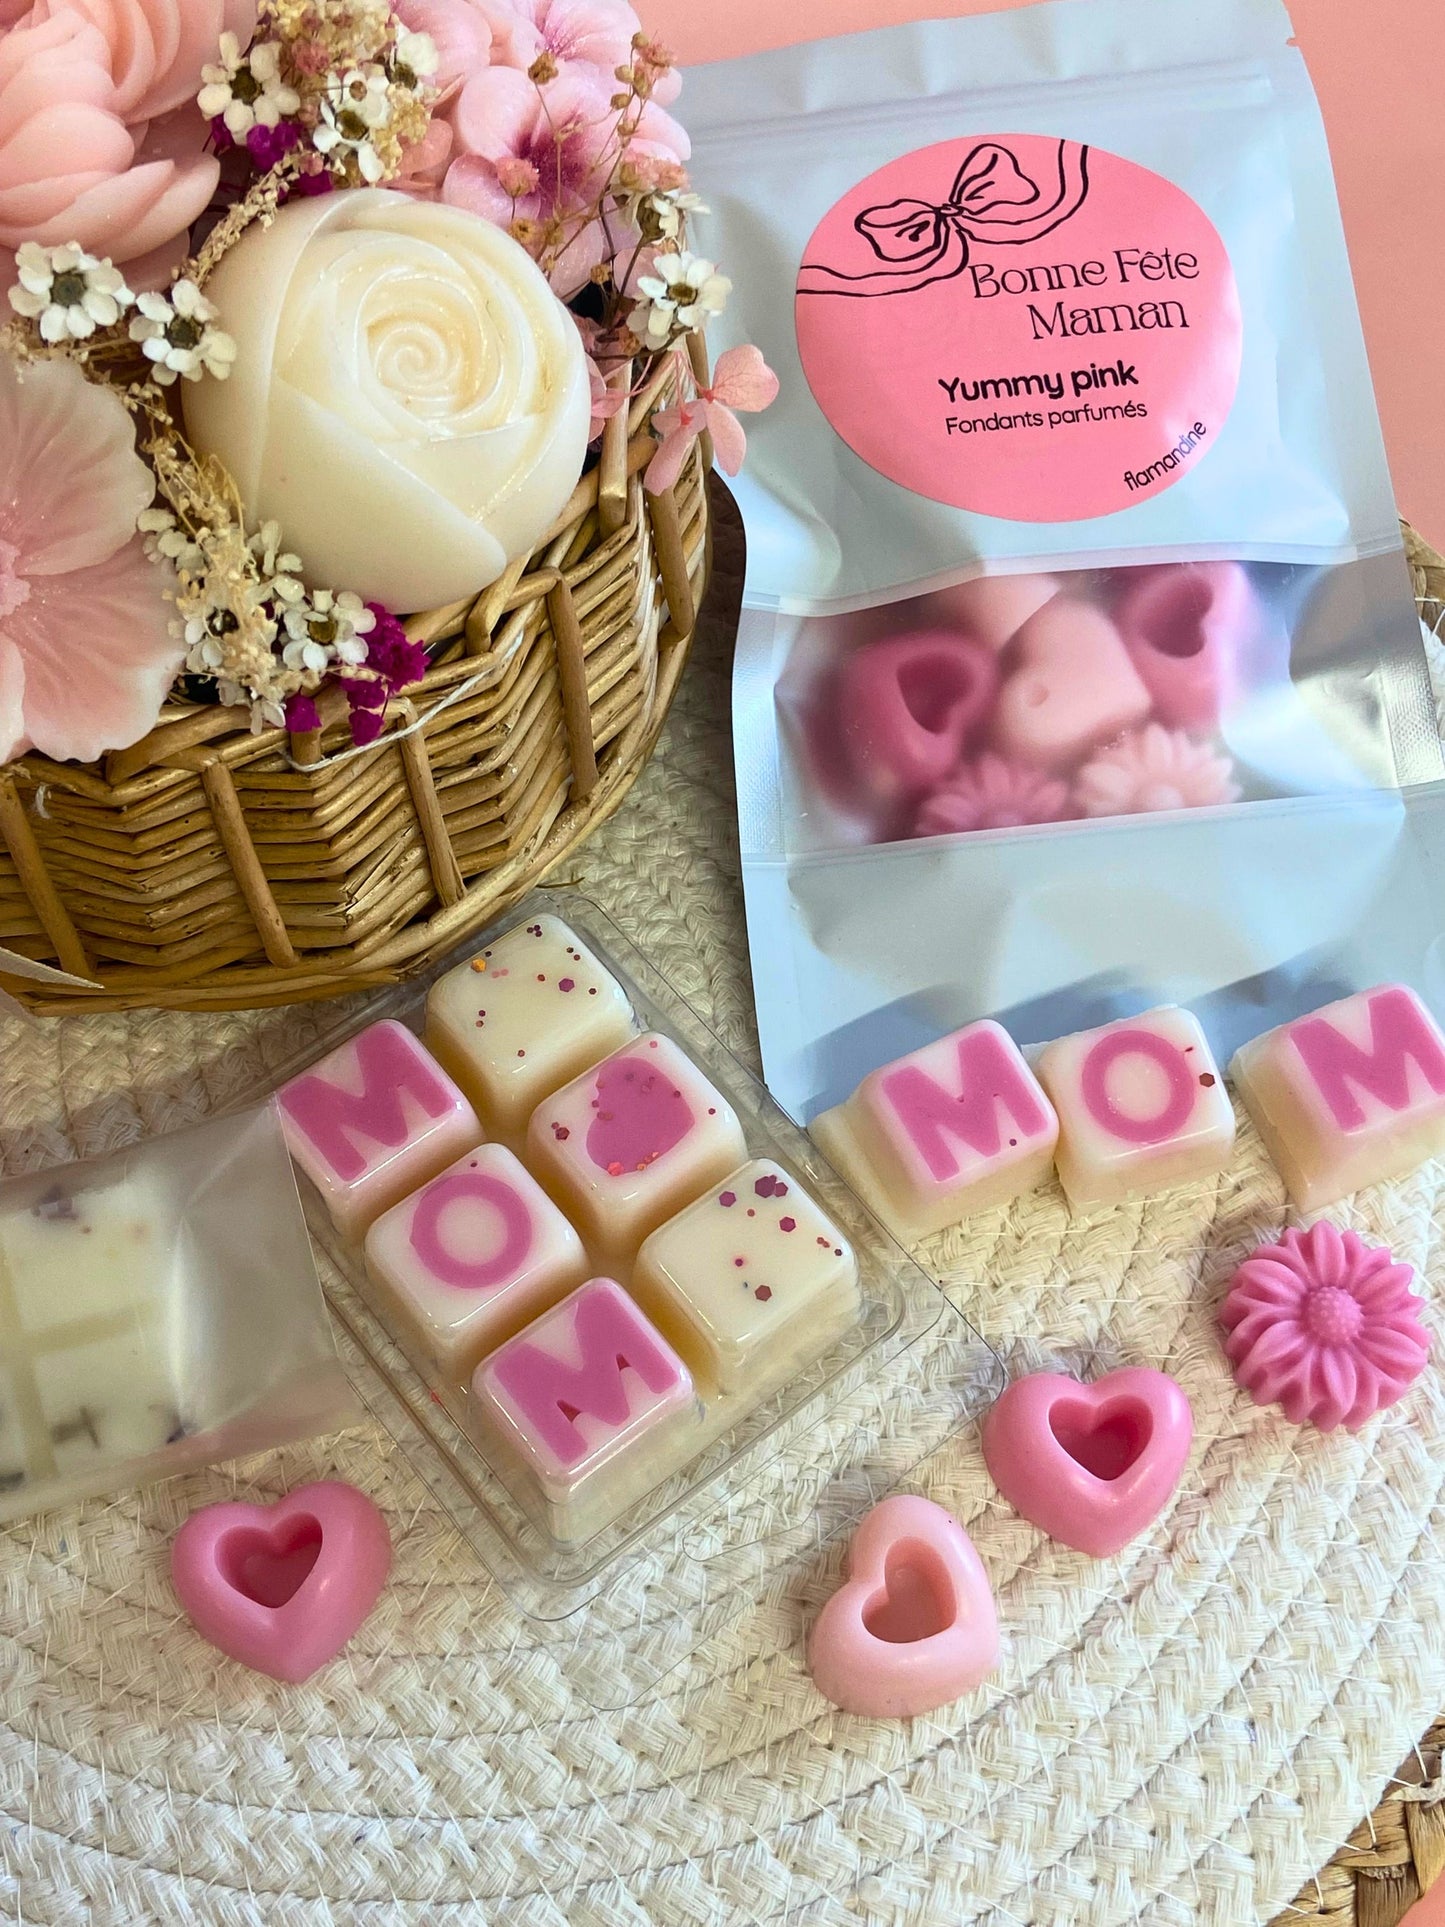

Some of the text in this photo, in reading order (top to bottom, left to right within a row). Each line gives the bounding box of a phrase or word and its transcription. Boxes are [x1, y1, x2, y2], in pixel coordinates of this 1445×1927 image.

[968, 247, 1200, 299] Bonne Fête
[1027, 299, 1190, 340] Maman
[938, 359, 1139, 403] Yummy pink
[946, 400, 1148, 435] Fondants parfumés
[1123, 420, 1207, 491] flamandine
